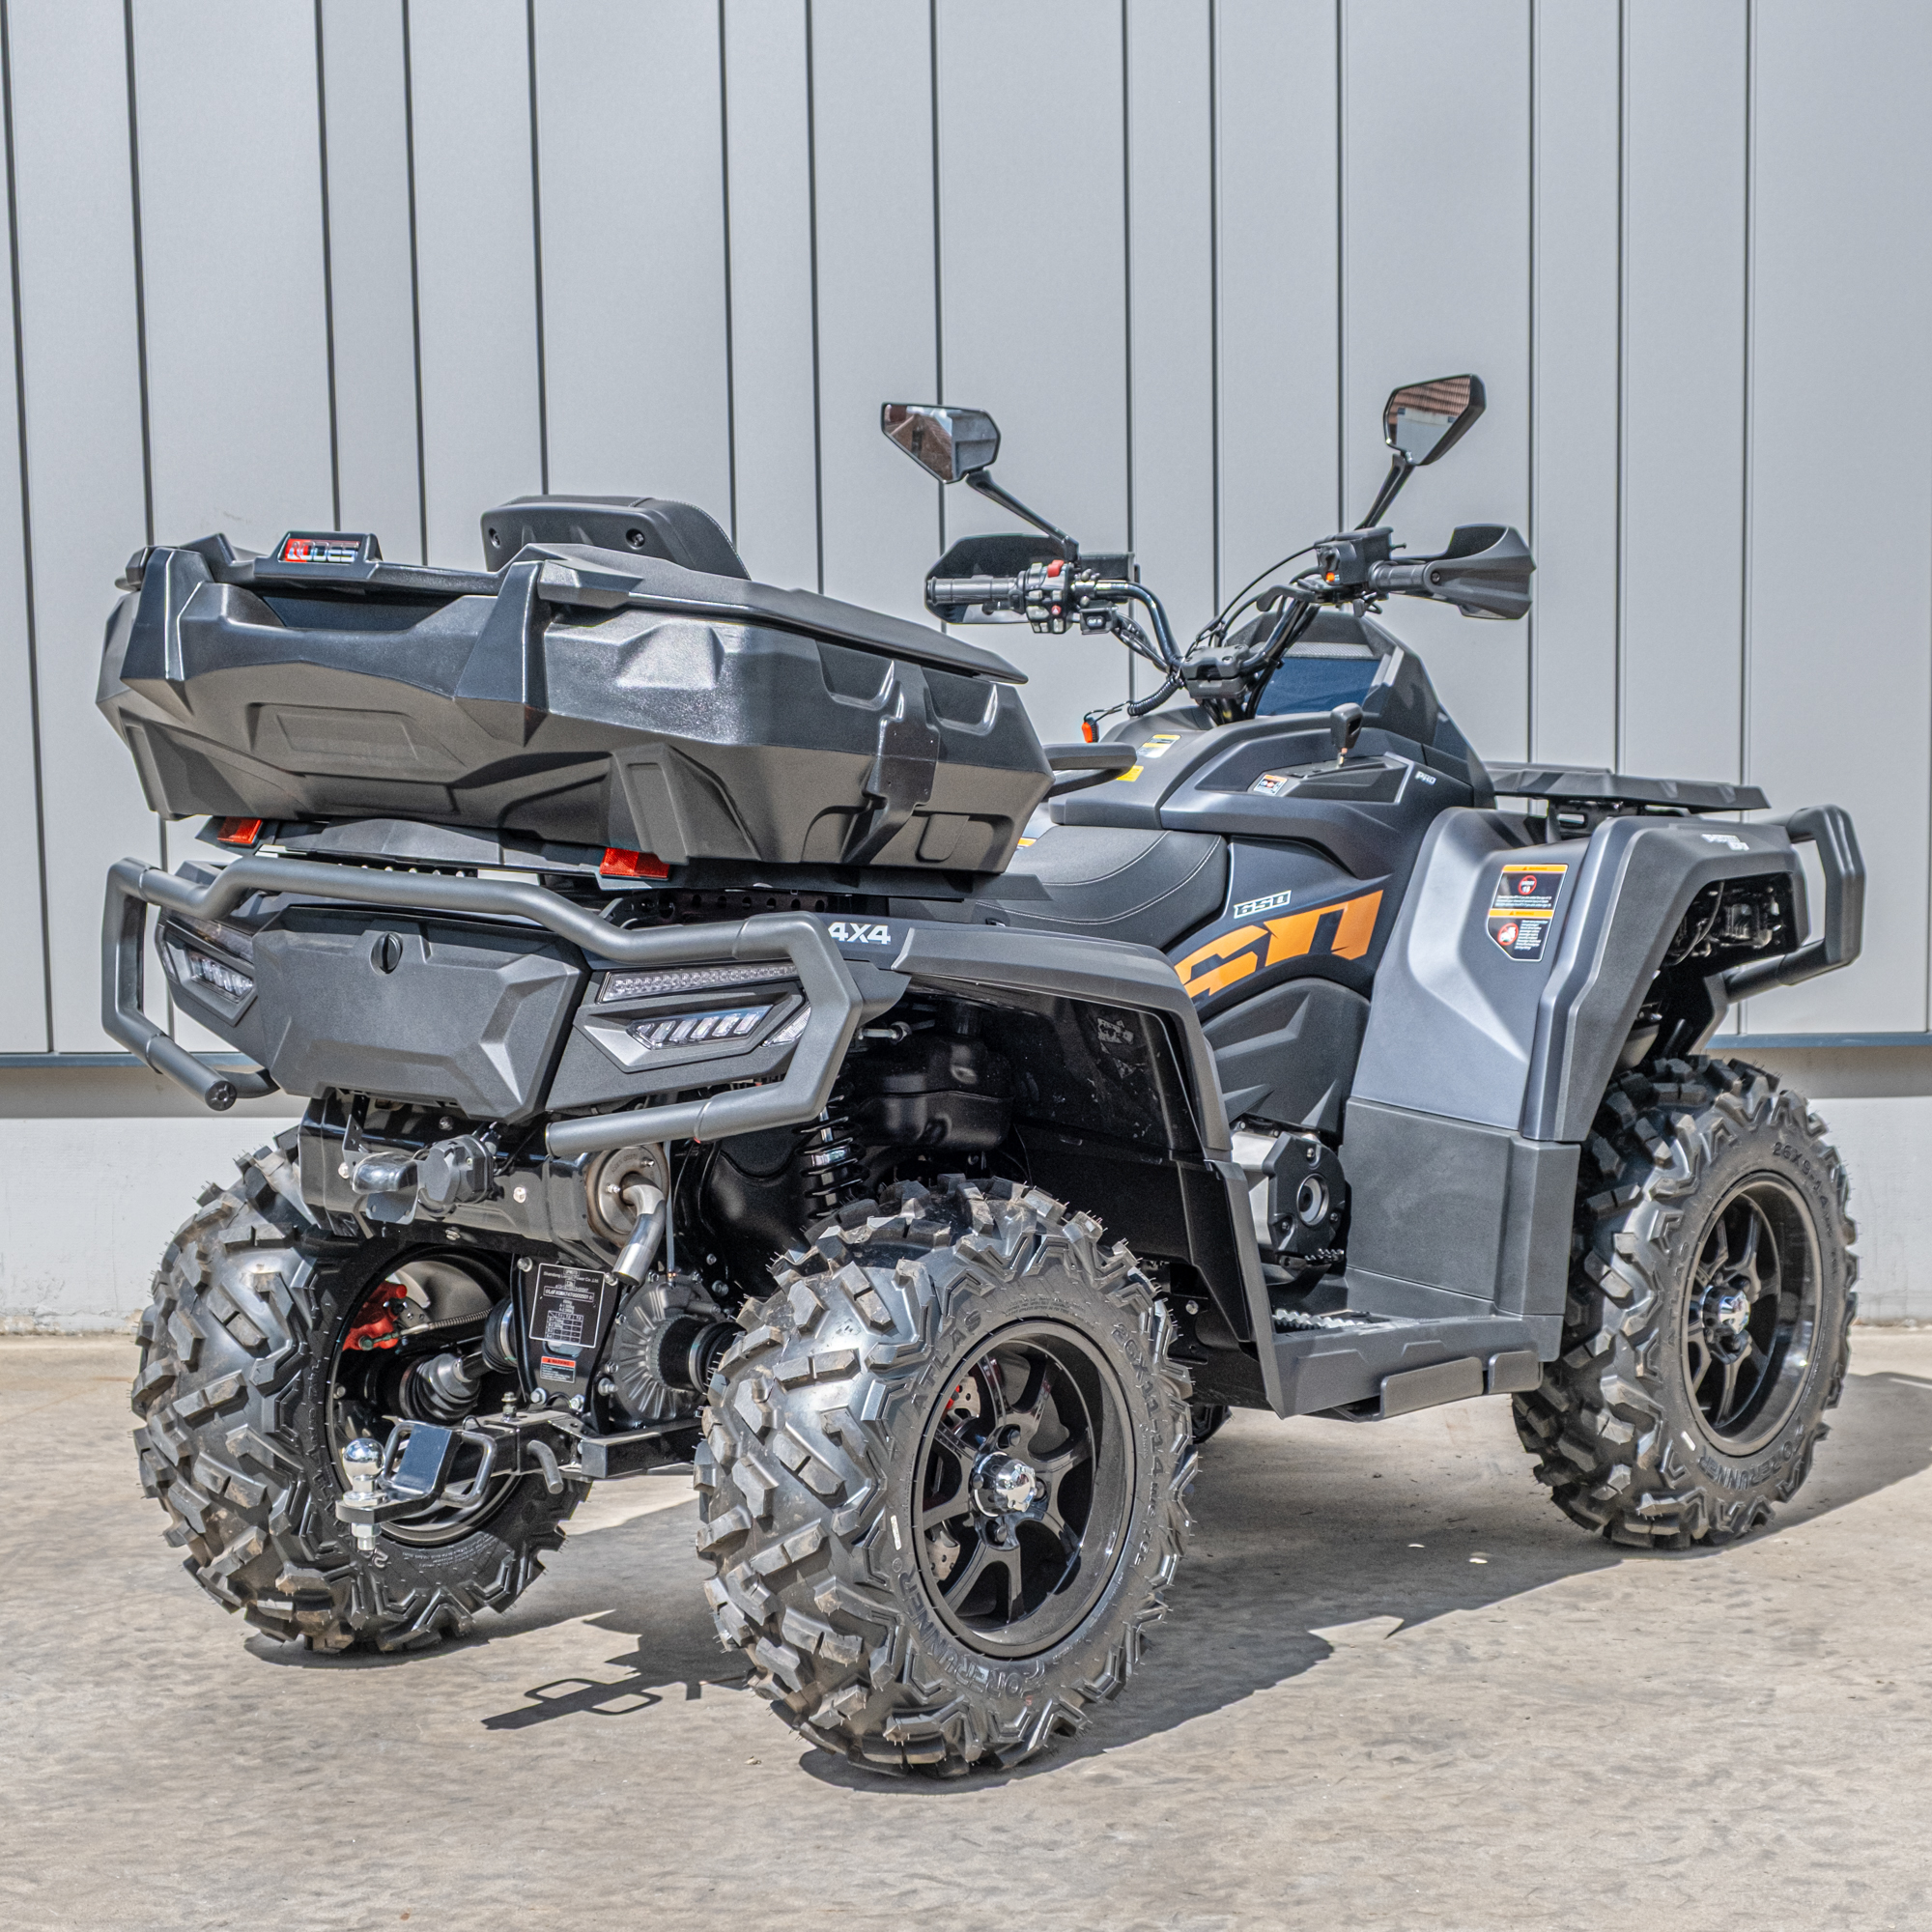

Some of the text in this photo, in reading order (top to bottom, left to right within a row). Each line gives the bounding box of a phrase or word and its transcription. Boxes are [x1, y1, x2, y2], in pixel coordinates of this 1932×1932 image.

[1415, 771, 1436, 785] PRO
[1234, 890, 1292, 919] 650
[911, 1310, 981, 1416] ATLAS
